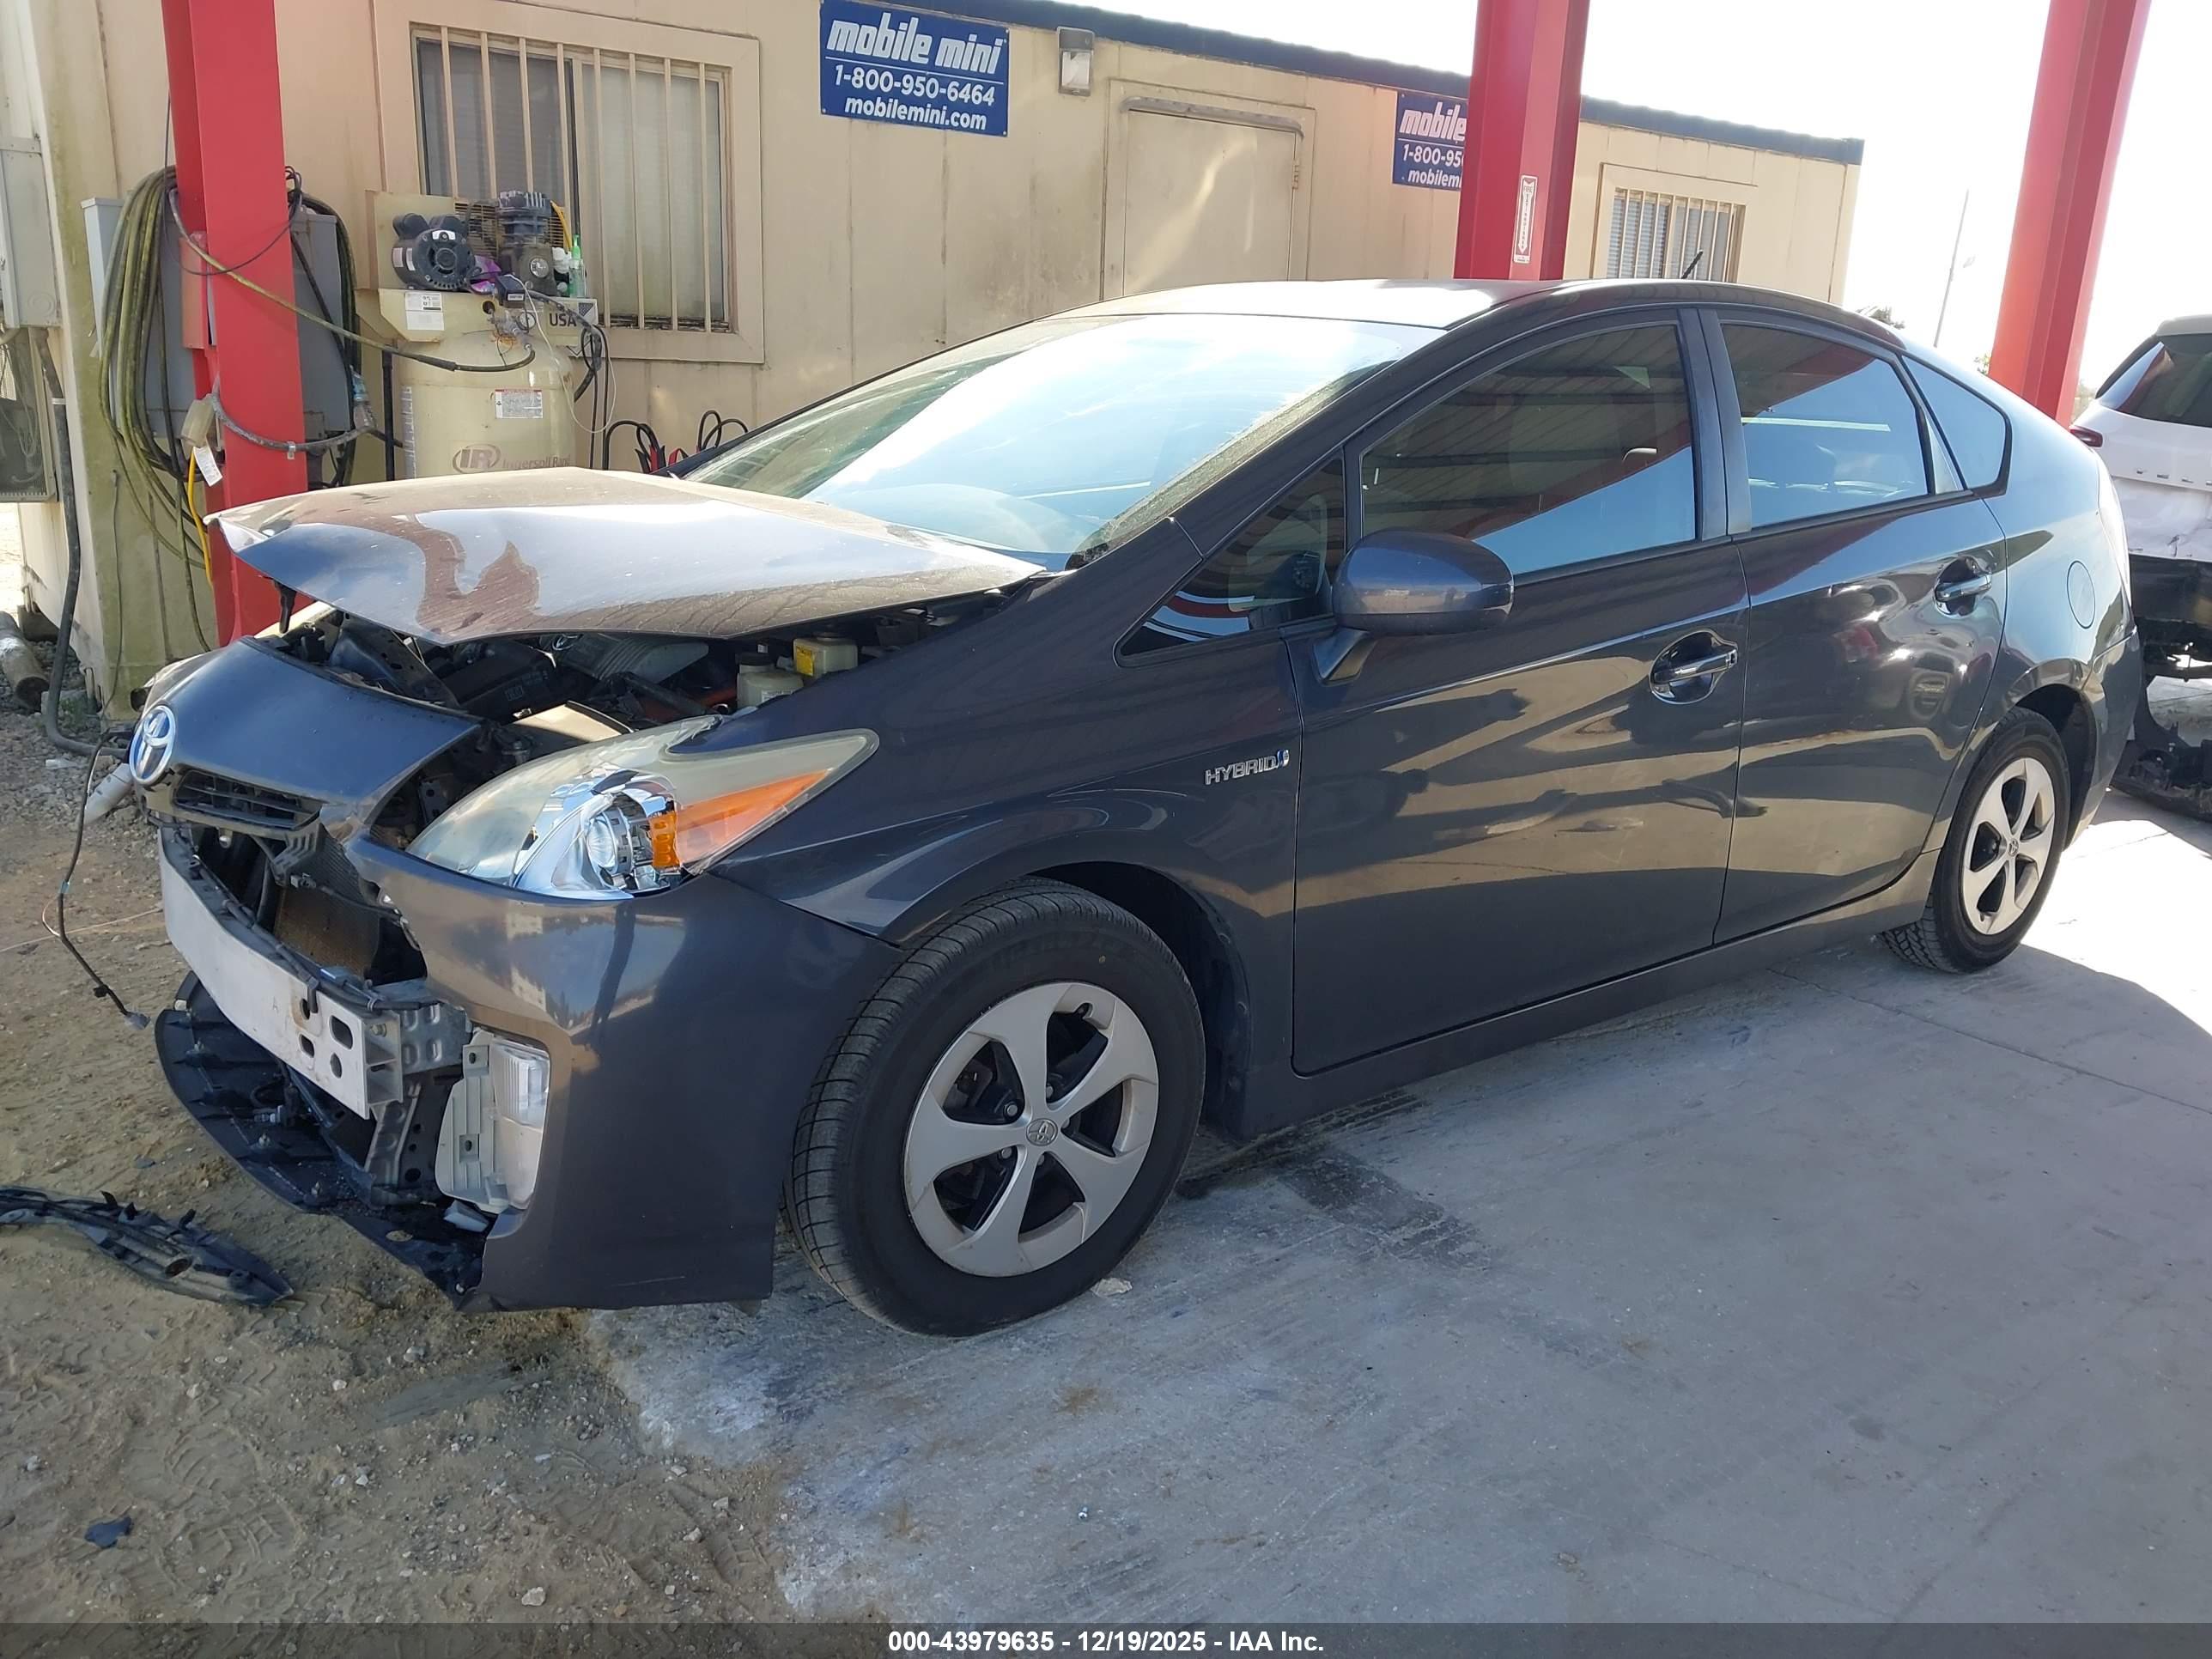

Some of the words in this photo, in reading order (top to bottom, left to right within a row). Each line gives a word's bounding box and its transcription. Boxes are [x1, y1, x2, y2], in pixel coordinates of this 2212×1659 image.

[826, 12, 933, 64] mobile
[934, 33, 1004, 75] mini
[835, 64, 995, 106] 1-800-950-6464
[844, 96, 988, 131] mobilemini.com
[1399, 101, 1468, 142] mobile
[1403, 143, 1464, 168] 1-800-95
[549, 313, 577, 327] USA
[1205, 755, 1278, 786] HYBRID
